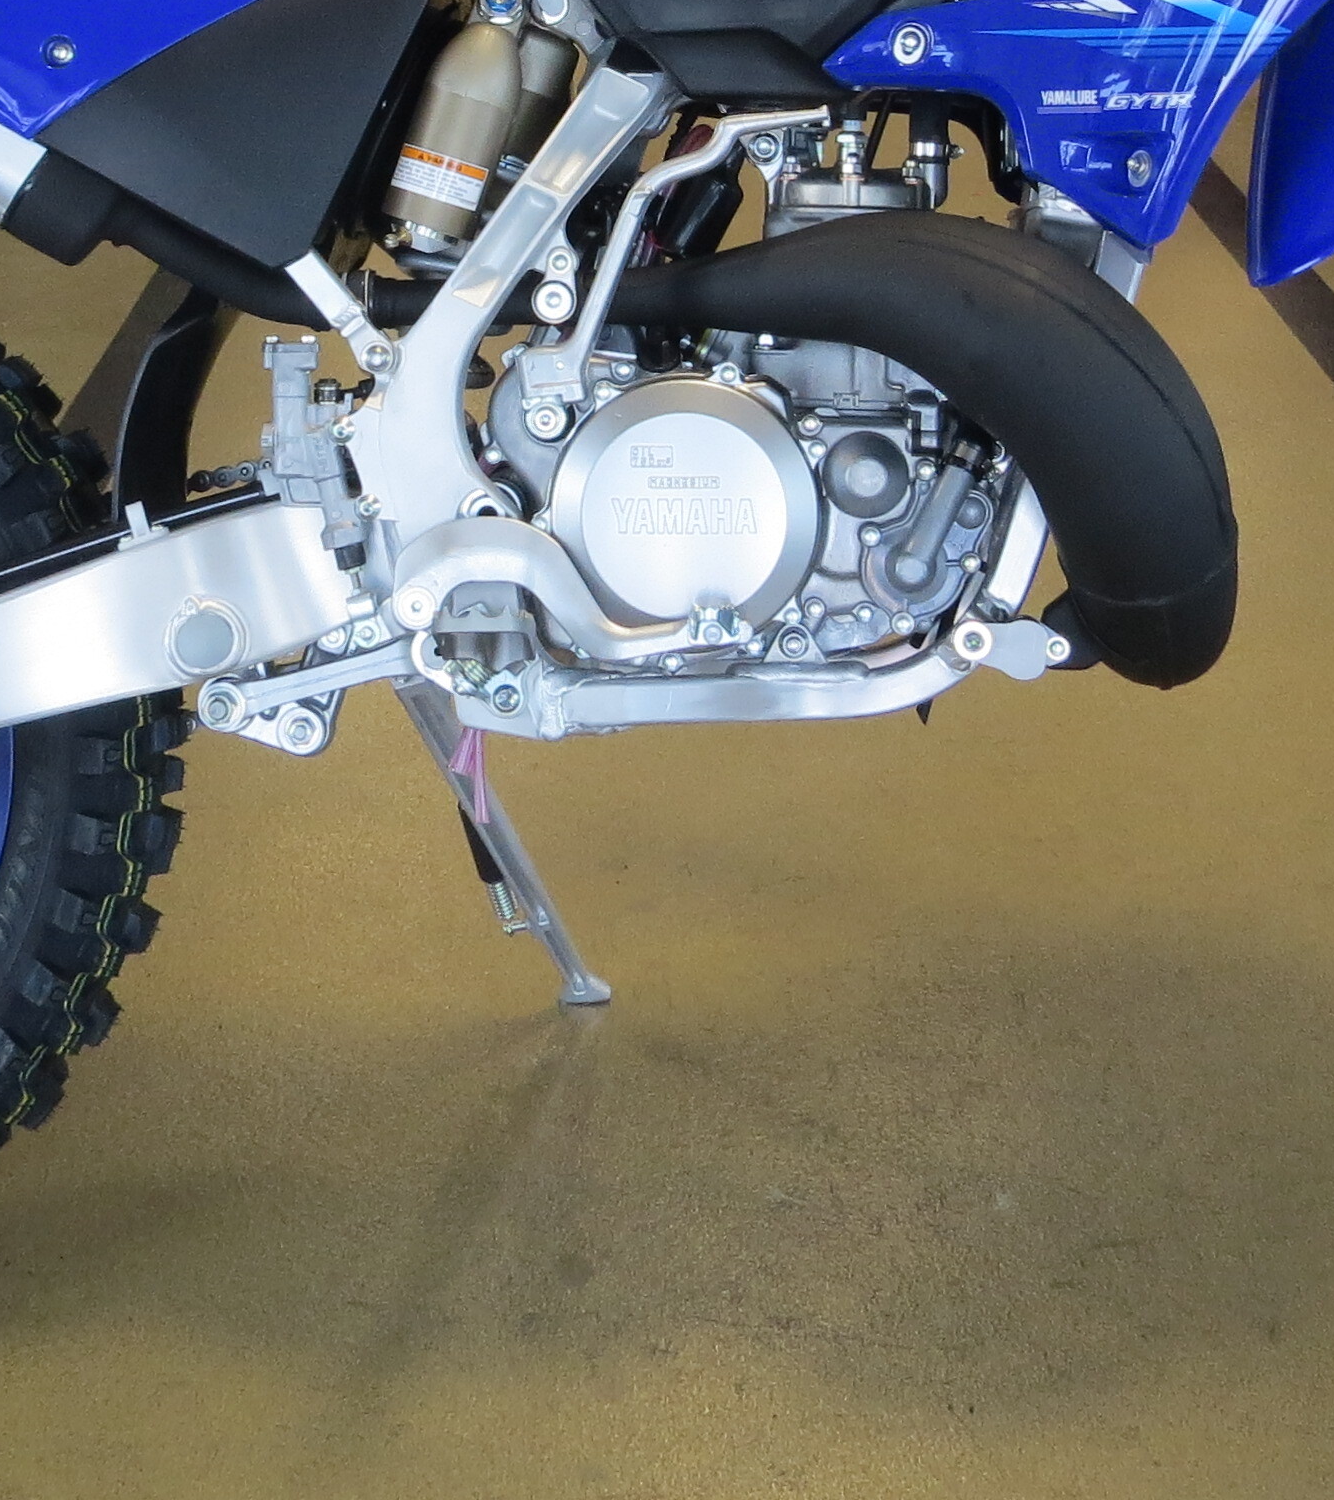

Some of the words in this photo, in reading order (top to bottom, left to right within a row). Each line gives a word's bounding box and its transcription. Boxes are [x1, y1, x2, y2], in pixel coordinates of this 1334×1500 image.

[1040, 89, 1098, 106] YAMALUBE
[1104, 91, 1197, 111] GYTR
[611, 497, 758, 535] YAMAHA
